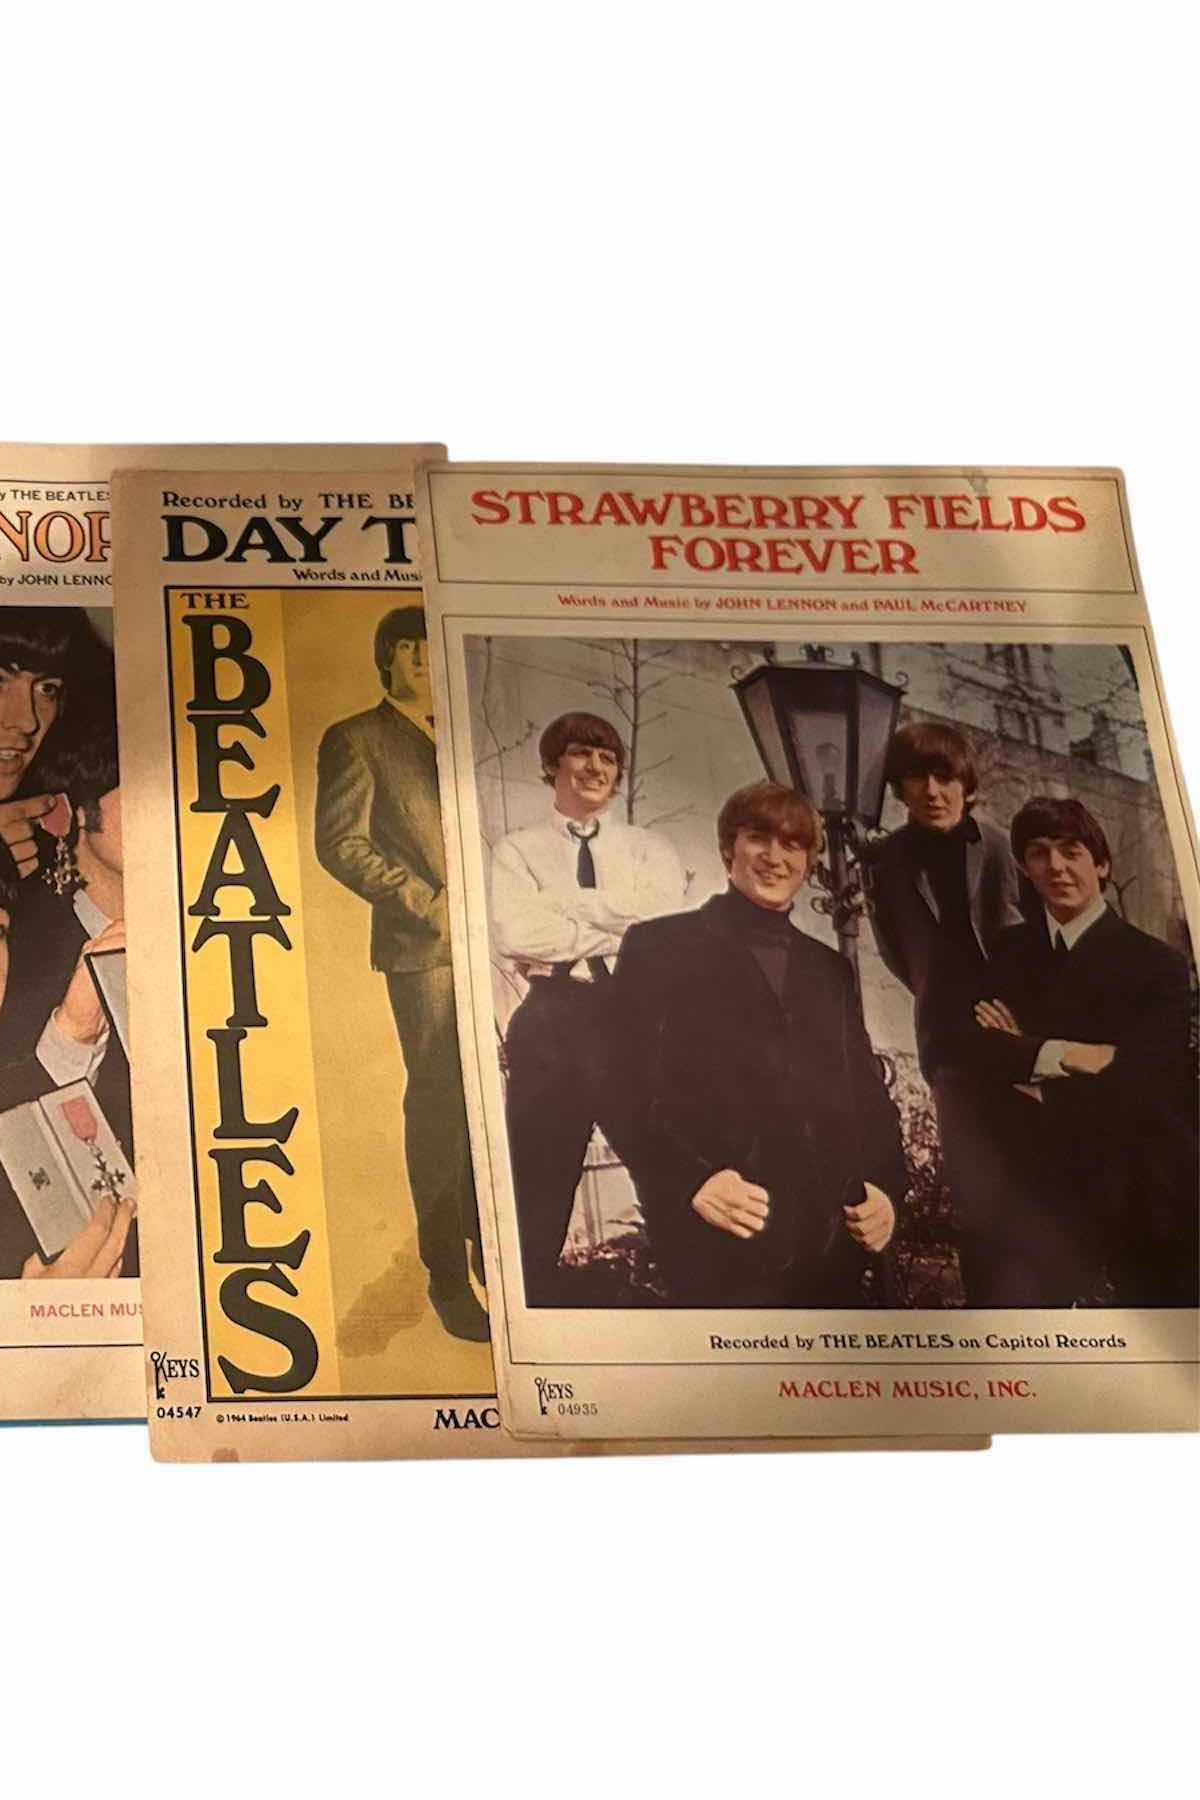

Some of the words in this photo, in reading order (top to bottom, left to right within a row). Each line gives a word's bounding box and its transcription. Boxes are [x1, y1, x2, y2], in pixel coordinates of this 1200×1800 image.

[10, 489, 40, 500] THE
[161, 491, 267, 510] Recorded
[278, 494, 303, 511] by
[319, 493, 373, 509] THE
[471, 490, 864, 530] STRAWBERRY
[884, 494, 1087, 534] FIELDS
[160, 514, 342, 563] DAY
[648, 534, 920, 576] FOREVER
[0, 574, 14, 586] by
[18, 574, 58, 585] JOHN
[292, 568, 346, 582] Words
[350, 569, 381, 581] and
[180, 592, 249, 609] THE
[558, 593, 606, 607] Words
[610, 597, 639, 608] and
[644, 595, 689, 608] Music
[694, 597, 711, 609] by
[715, 597, 760, 609] JOHN
[766, 598, 837, 611] LENNON
[841, 599, 868, 611] and
[873, 599, 917, 612] PAUL
[920, 599, 1026, 613] McCARTNEY
[181, 614, 319, 1394] BEATLES
[30, 1303, 104, 1318] MACLEN
[709, 1334, 789, 1350] Recorded
[797, 1335, 815, 1352] by
[819, 1334, 860, 1349] THE
[865, 1333, 954, 1349] BEATLES
[959, 1338, 980, 1349] on
[985, 1334, 1050, 1351] Capitol
[1055, 1333, 1127, 1349] Records
[778, 1380, 881, 1398] MACLEN
[892, 1380, 979, 1400] MUSIC,
[987, 1379, 1037, 1398] INC.
[157, 1406, 202, 1419] 04547
[558, 1403, 598, 1416] 04935
